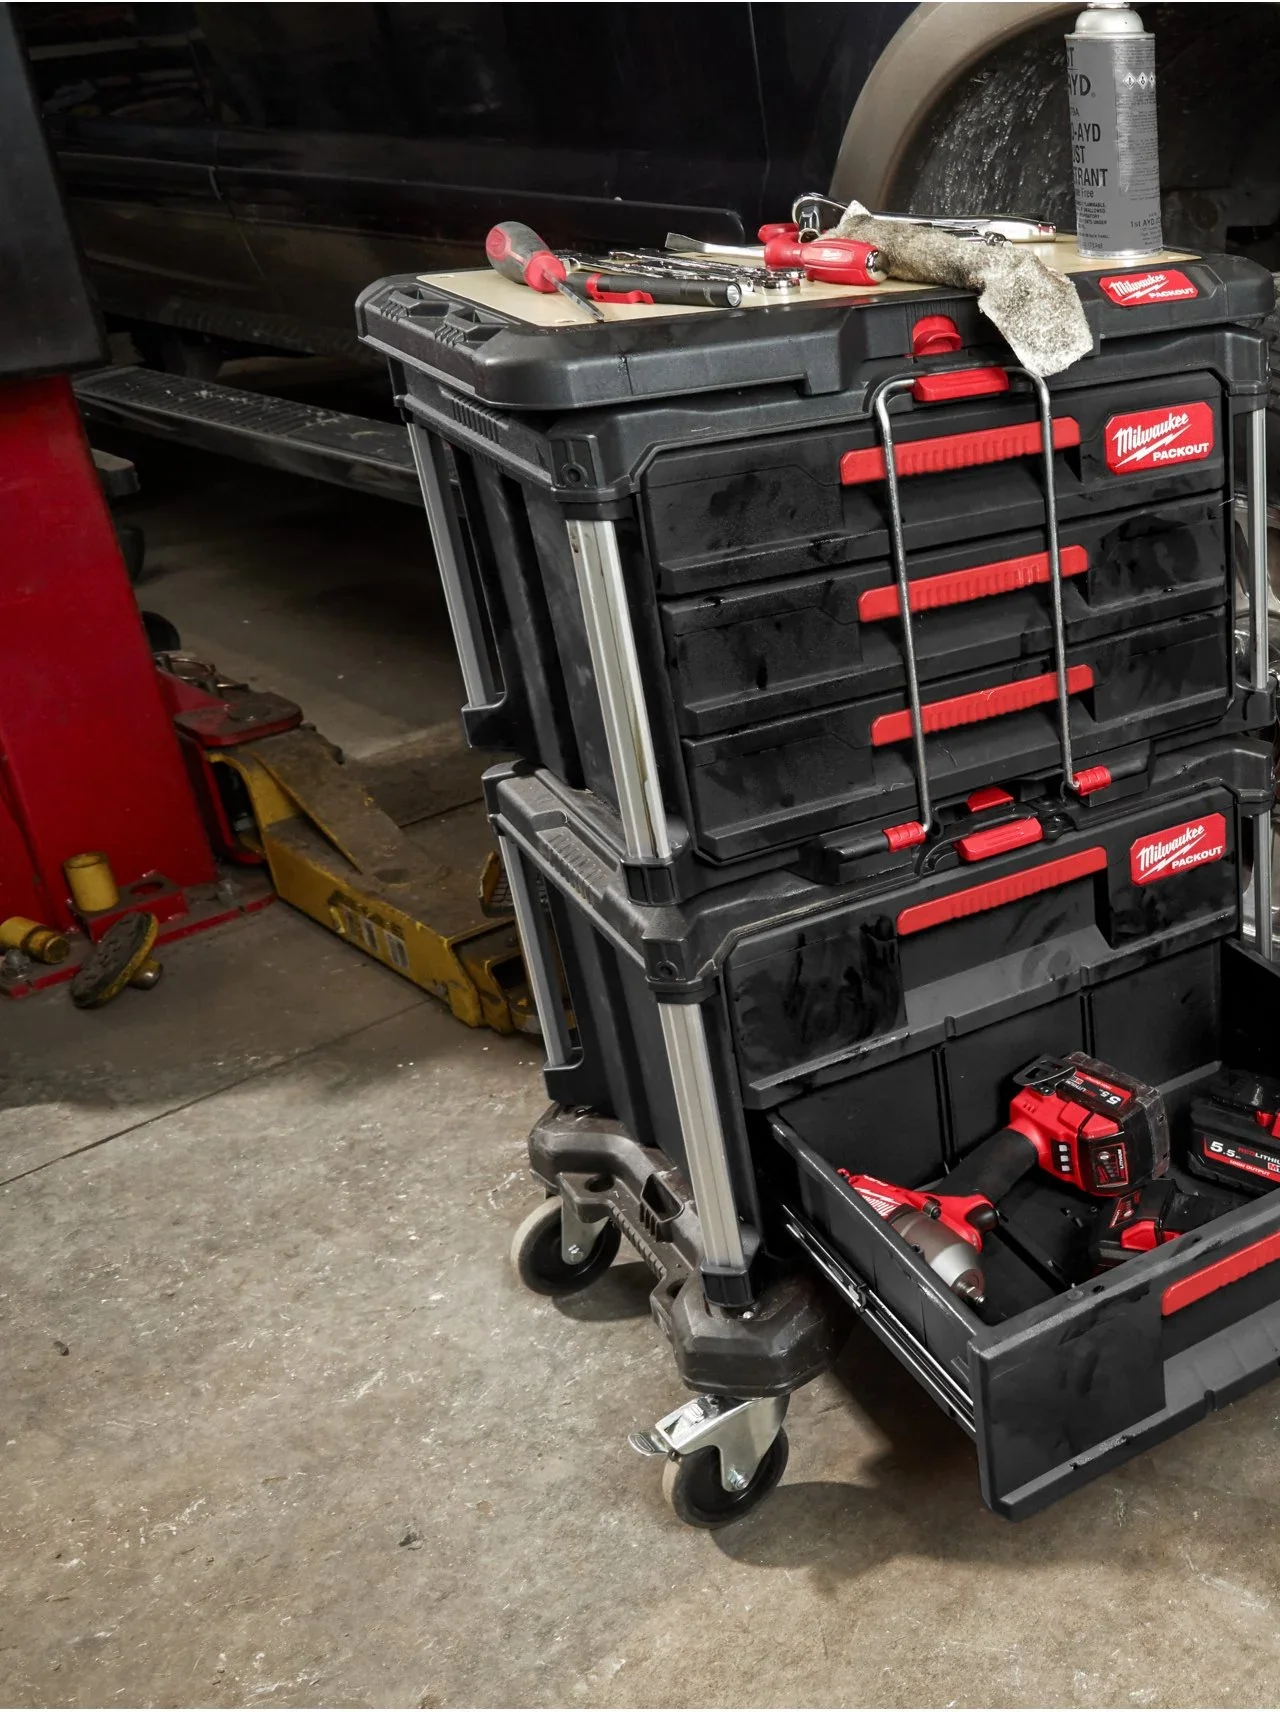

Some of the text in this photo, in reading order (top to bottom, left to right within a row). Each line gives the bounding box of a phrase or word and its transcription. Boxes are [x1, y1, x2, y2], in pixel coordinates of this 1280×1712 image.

[1108, 274, 1166, 297] Milwaukee
[1148, 288, 1195, 299] PACKOUT
[1112, 413, 1190, 457] Milwaukee
[1153, 443, 1210, 461] PACKOUT
[1136, 825, 1205, 871] Milwaukee
[1171, 846, 1223, 869] PACKOUT
[1244, 1164, 1271, 1176] OUTPUT
